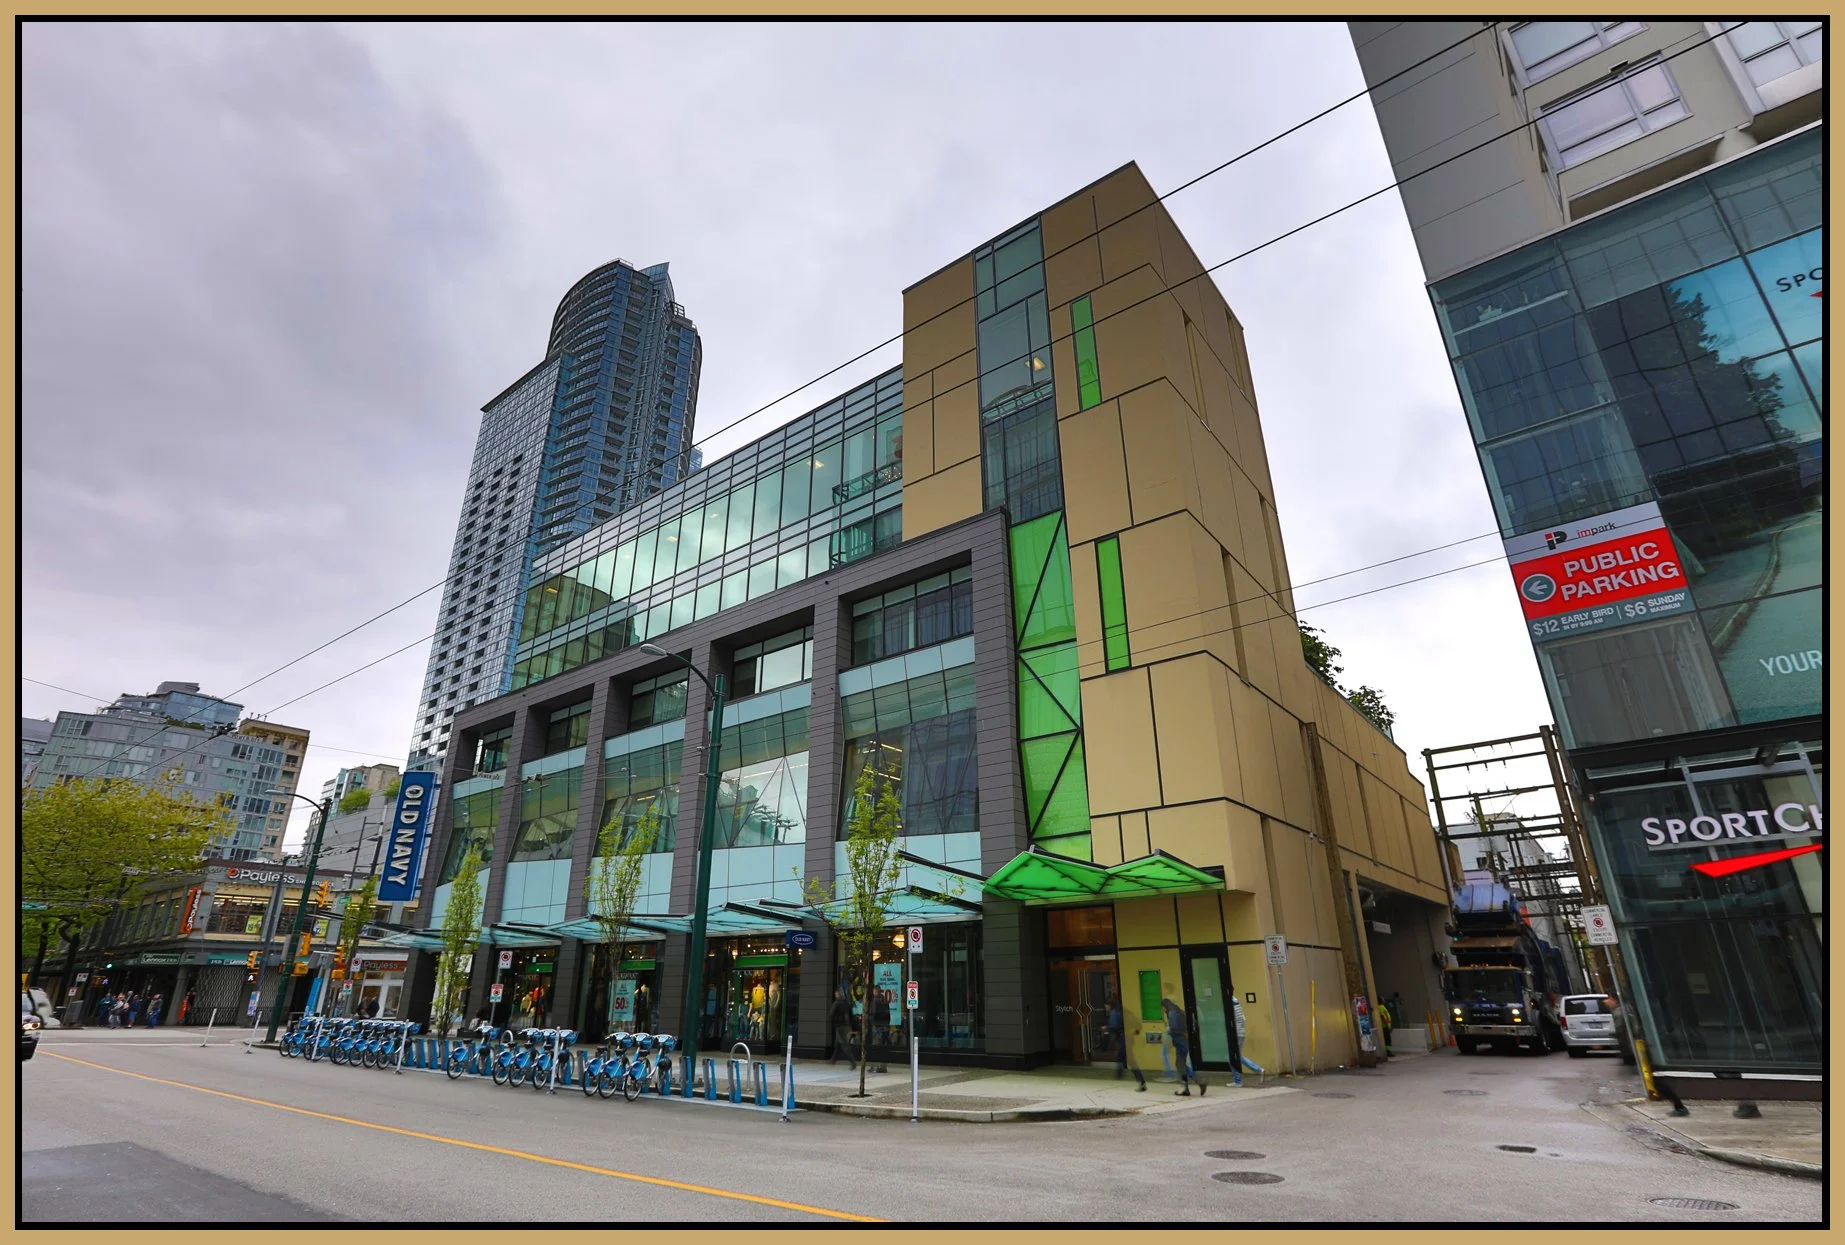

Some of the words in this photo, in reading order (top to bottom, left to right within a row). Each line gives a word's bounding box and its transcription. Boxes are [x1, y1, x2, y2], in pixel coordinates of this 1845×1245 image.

[1577, 522, 1616, 537] impark
[1563, 542, 1660, 578] PUBLIC
[1560, 561, 1679, 601] PARKING
[1532, 620, 1560, 636] $12
[1560, 612, 1589, 625] EARLY
[1592, 607, 1614, 619] BIRD
[1624, 601, 1647, 618] $6
[1647, 592, 1686, 607] SUNDAY
[1650, 602, 1681, 613] MAXIMUM
[1759, 650, 1822, 676] YOUR
[400, 784, 424, 824] OLD
[387, 828, 416, 886] NAVY
[240, 869, 295, 884] Payless
